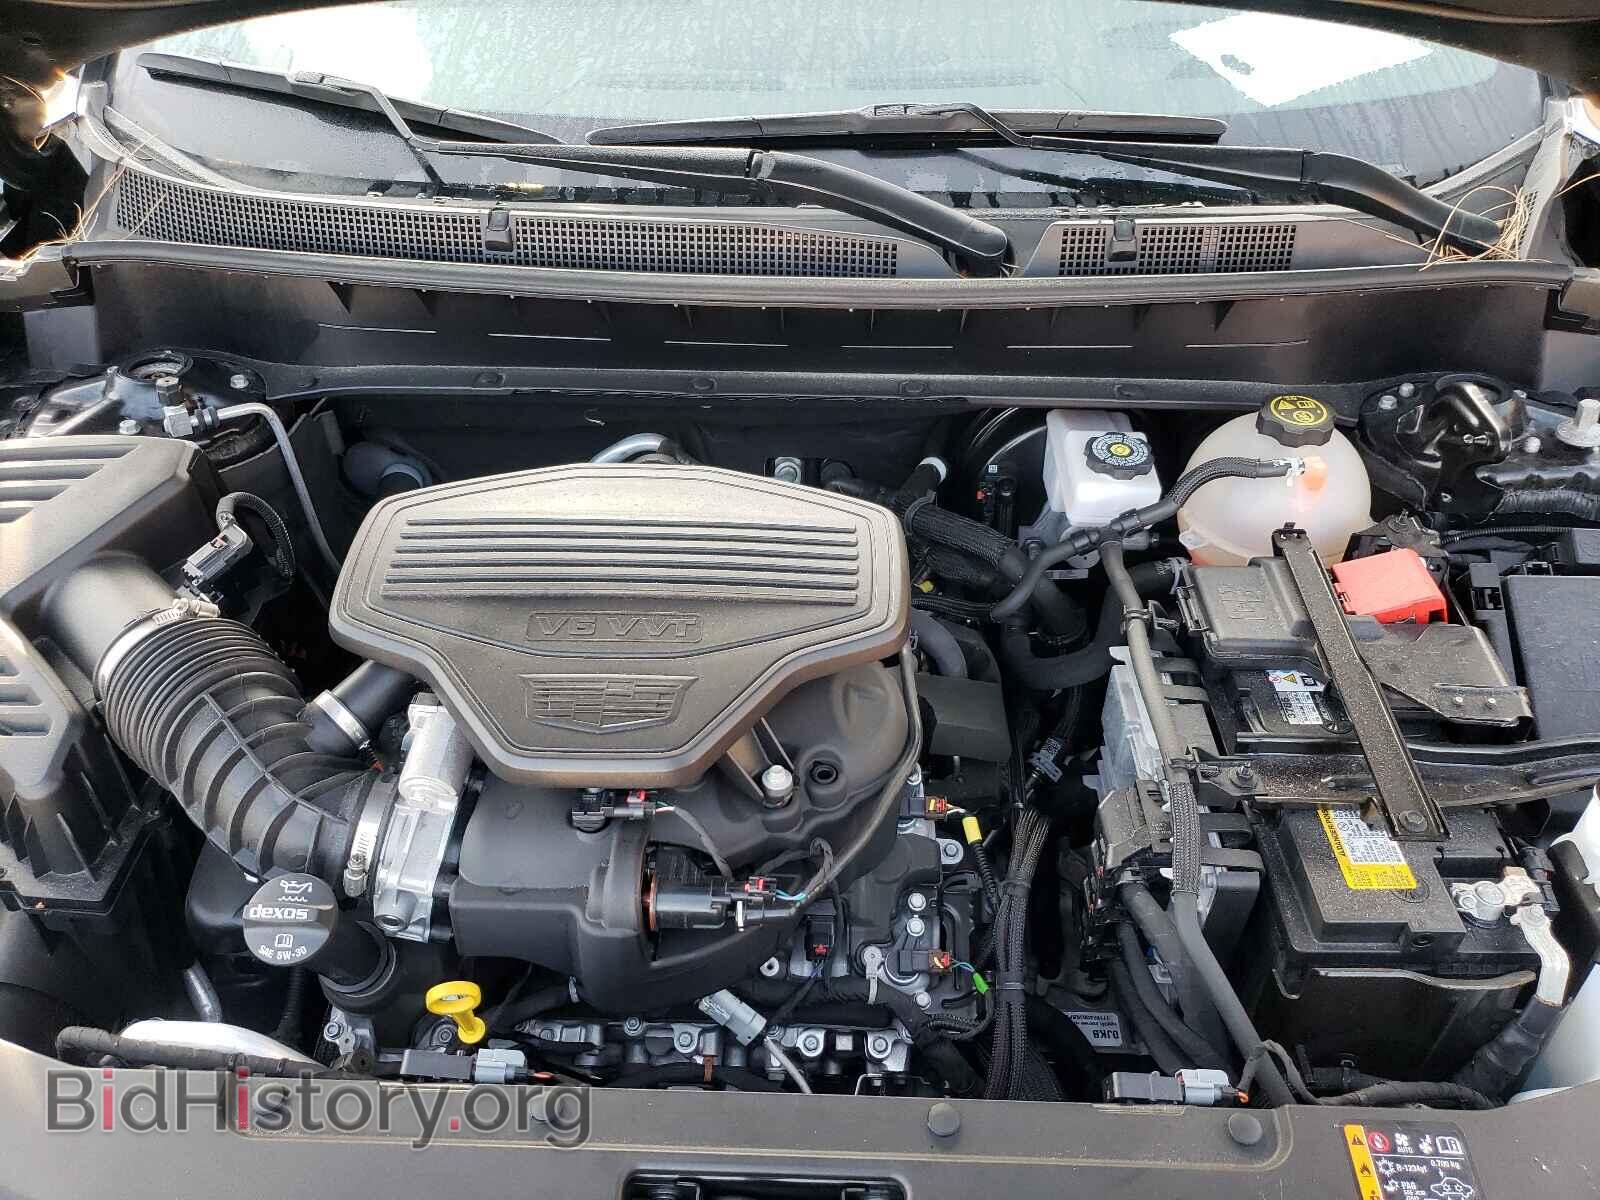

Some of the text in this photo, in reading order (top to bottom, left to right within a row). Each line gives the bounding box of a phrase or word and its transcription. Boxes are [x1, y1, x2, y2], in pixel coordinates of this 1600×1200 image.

[535, 616, 698, 637] V6 VVT
[249, 904, 308, 920] dexos
[258, 945, 308, 961] SAE 5W-30
